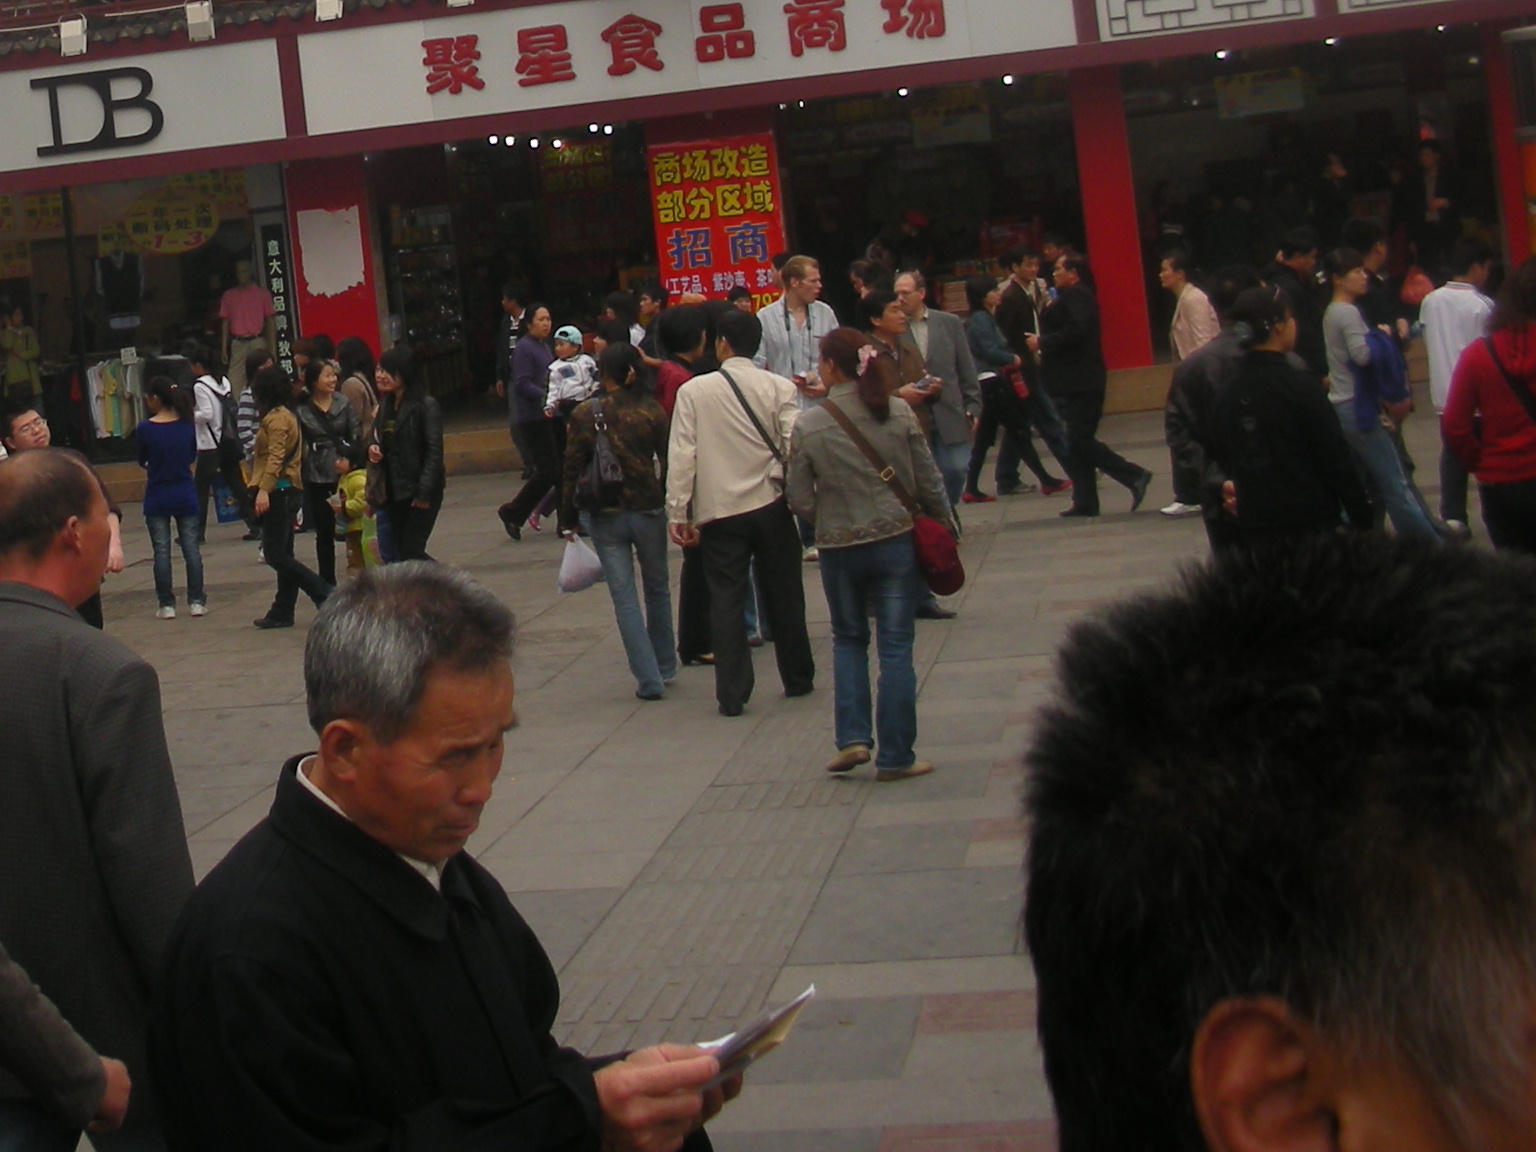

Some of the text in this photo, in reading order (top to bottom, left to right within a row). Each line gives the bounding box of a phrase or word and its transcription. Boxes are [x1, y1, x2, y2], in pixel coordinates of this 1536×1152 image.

[29, 66, 165, 157] DB
[652, 142, 770, 187] 商场改造
[655, 180, 776, 225] 部分区域
[666, 220, 770, 272] 招商
